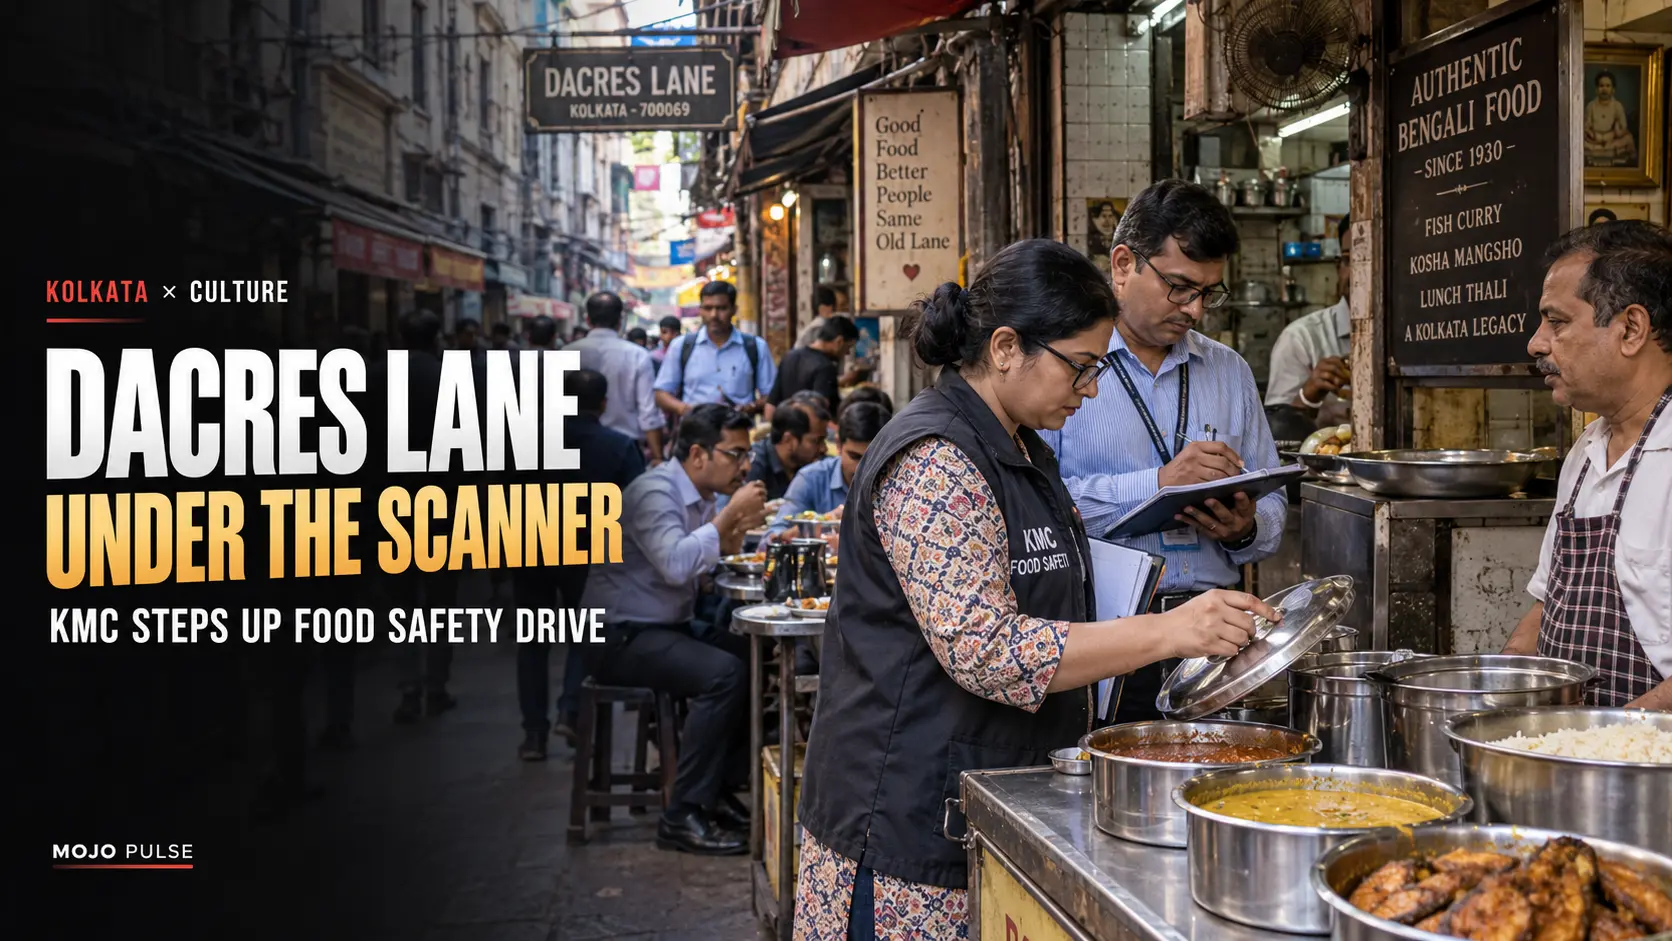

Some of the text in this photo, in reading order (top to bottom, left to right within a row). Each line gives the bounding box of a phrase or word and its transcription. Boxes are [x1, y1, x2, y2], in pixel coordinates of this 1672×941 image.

[544, 65, 716, 98] DACRES LANE
[1410, 36, 1523, 108] AUTHENTIC
[570, 103, 627, 118] KOLKATA
[640, 102, 690, 117] 700069
[1398, 78, 1542, 153] BENGALI FOOD
[875, 114, 921, 134] Good
[876, 137, 918, 157] Food
[876, 163, 928, 181] Better
[876, 185, 932, 207] People
[876, 210, 922, 228] Same
[1425, 203, 1502, 238] FISH CURRY
[876, 232, 950, 251] Old Lane
[1410, 237, 1523, 275] KOSHA MANGSHO
[1420, 278, 1507, 309] LUNCH THALI
[1404, 312, 1527, 342] A KOLKATA LEGACY
[1023, 526, 1057, 553] KMC
[1010, 557, 1041, 575] FOOD
